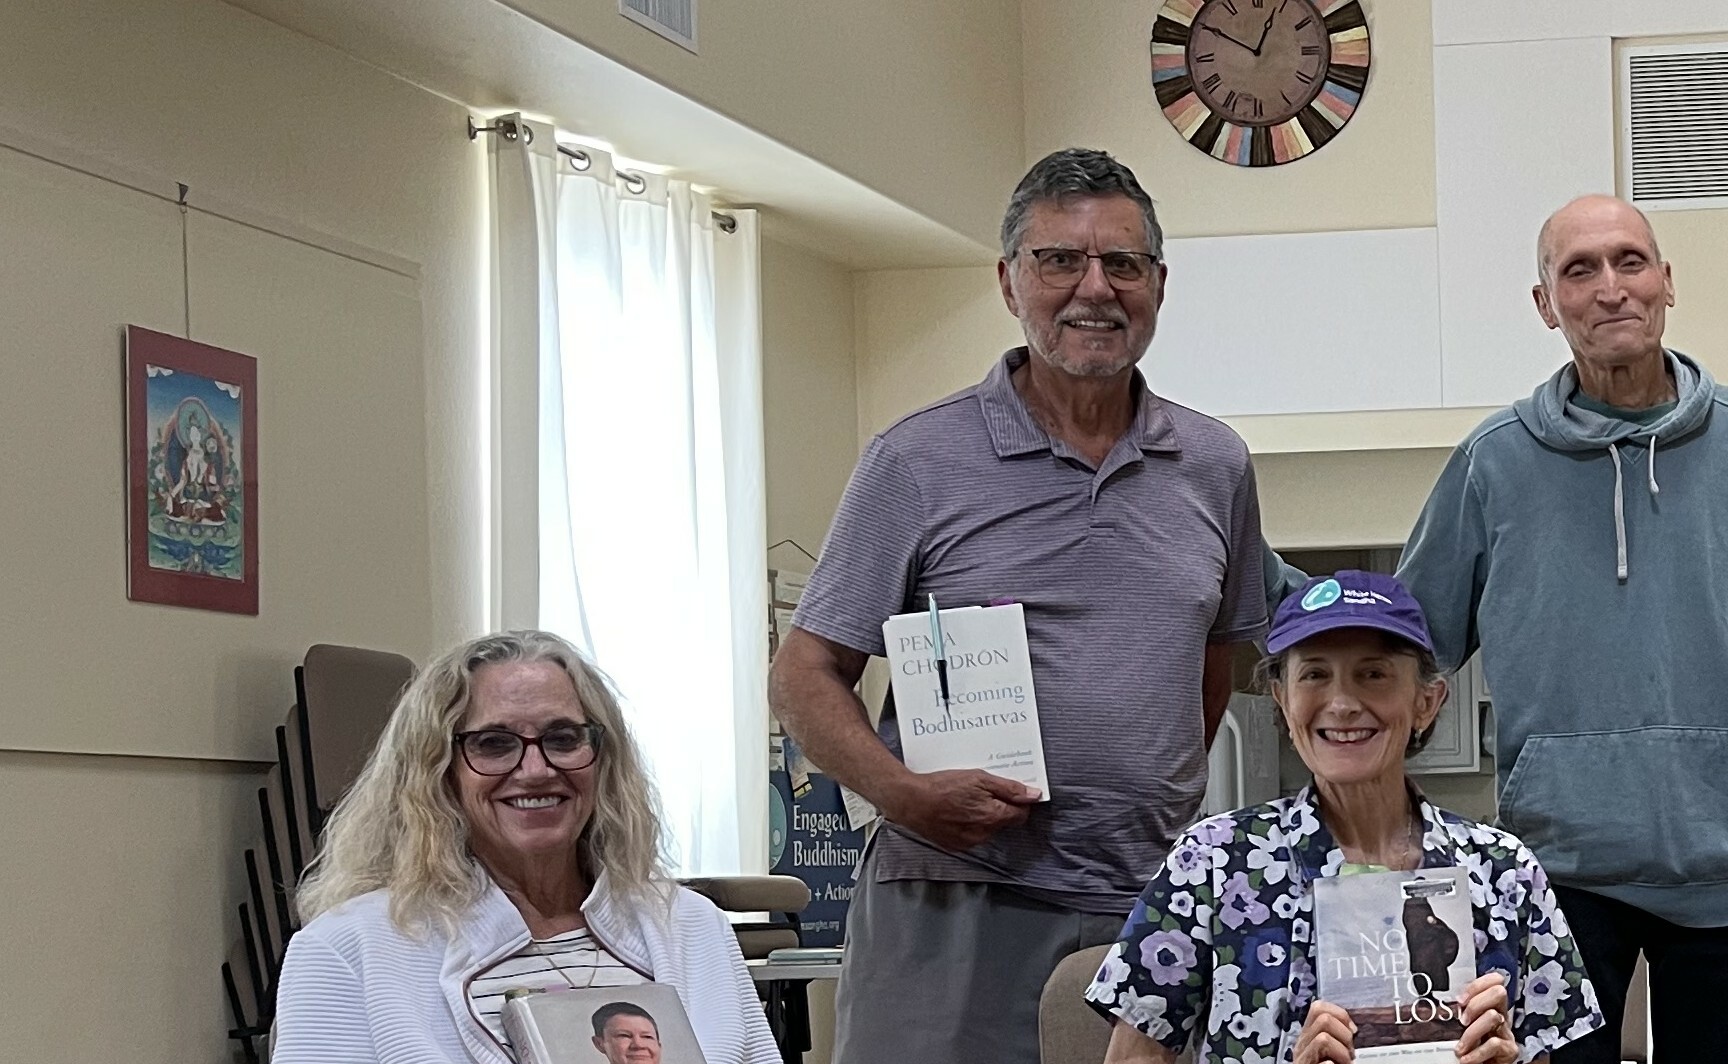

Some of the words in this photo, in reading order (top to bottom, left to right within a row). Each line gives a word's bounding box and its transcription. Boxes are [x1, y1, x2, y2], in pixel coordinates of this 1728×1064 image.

[911, 710, 1028, 737] Bodhisattvas
[793, 840, 859, 867] Buddhism
[824, 882, 853, 901] Actio
[1359, 928, 1406, 954] NO
[1328, 952, 1412, 980] TIME
[1384, 972, 1433, 999] TO
[1394, 998, 1462, 1025] LOS
